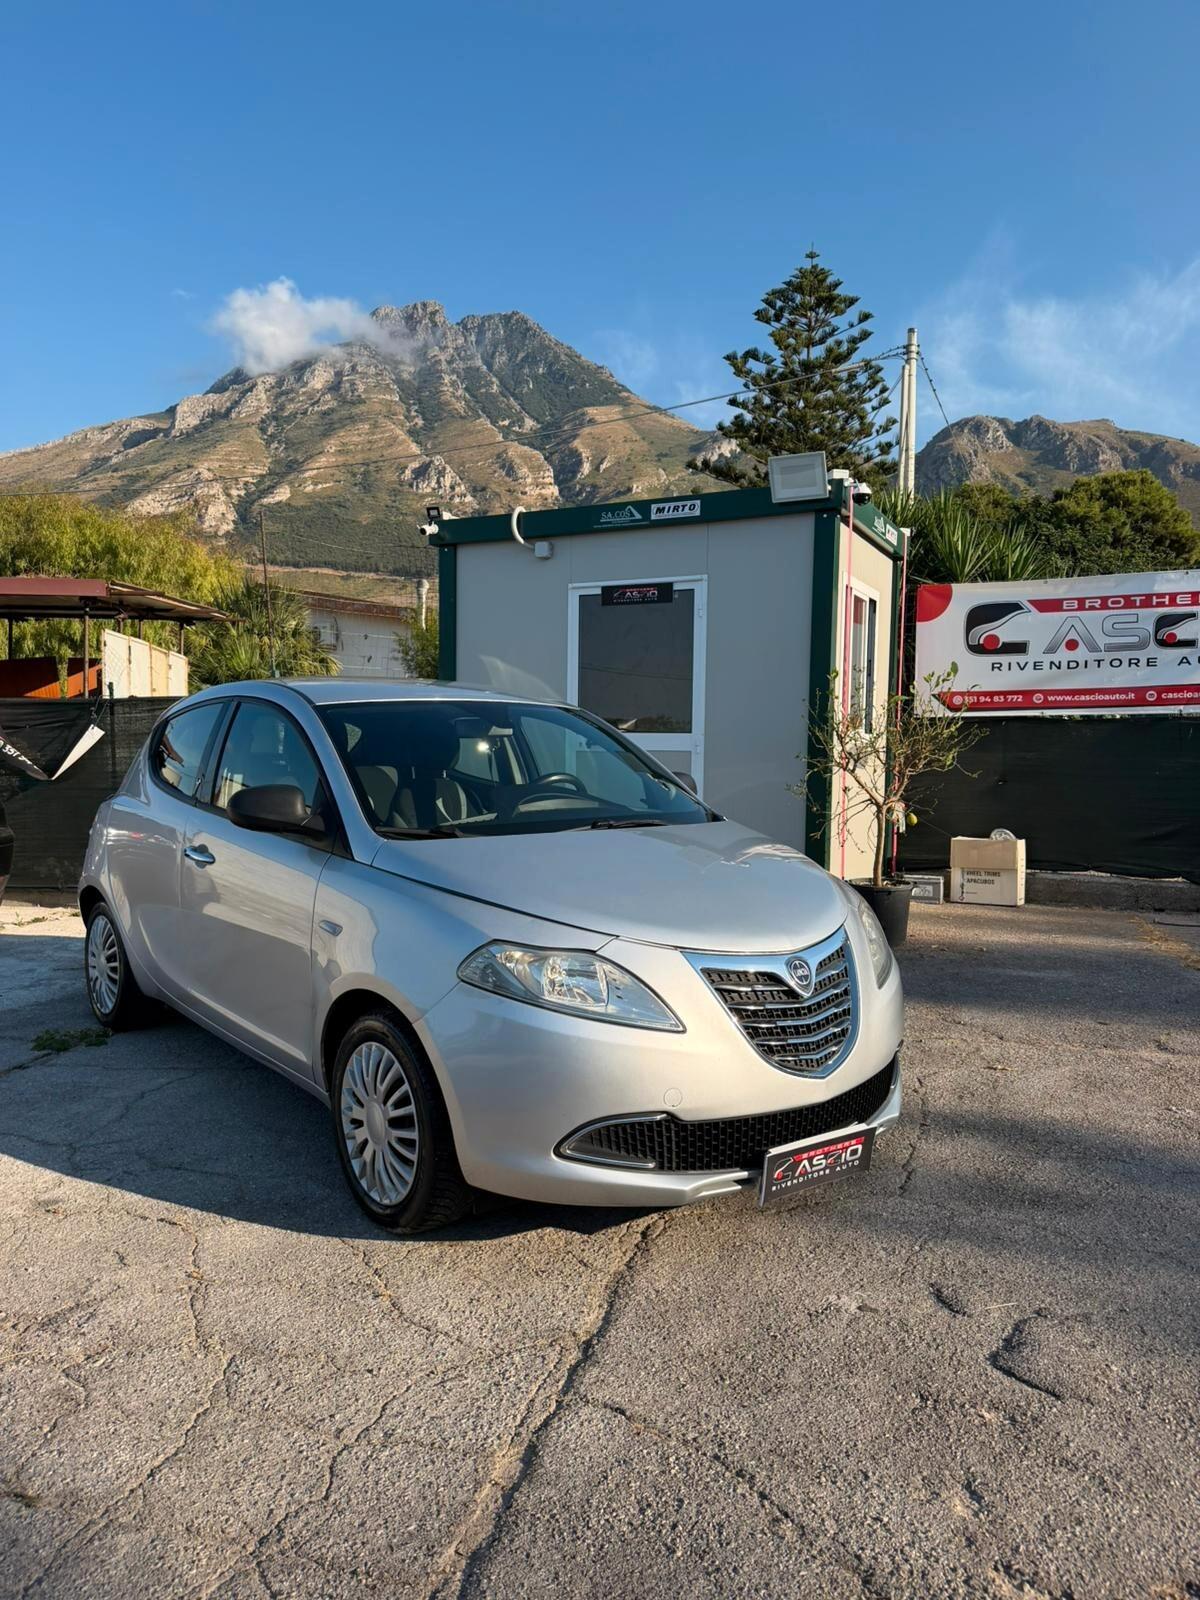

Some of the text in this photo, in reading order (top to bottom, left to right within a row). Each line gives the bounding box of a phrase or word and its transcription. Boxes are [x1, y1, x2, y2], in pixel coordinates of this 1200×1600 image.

[655, 503, 697, 515] MIRTO
[1062, 594, 1200, 610] BROTHE
[991, 656, 1200, 672] RIVENDITORE A
[979, 695, 991, 703] 94
[993, 694, 1005, 703] 83
[1006, 694, 1023, 702] 772
[1047, 691, 1135, 702] www.cascioauto.it
[1161, 690, 1200, 699] cascioa
[771, 1160, 860, 1192] RIVENDITORE AUTO
